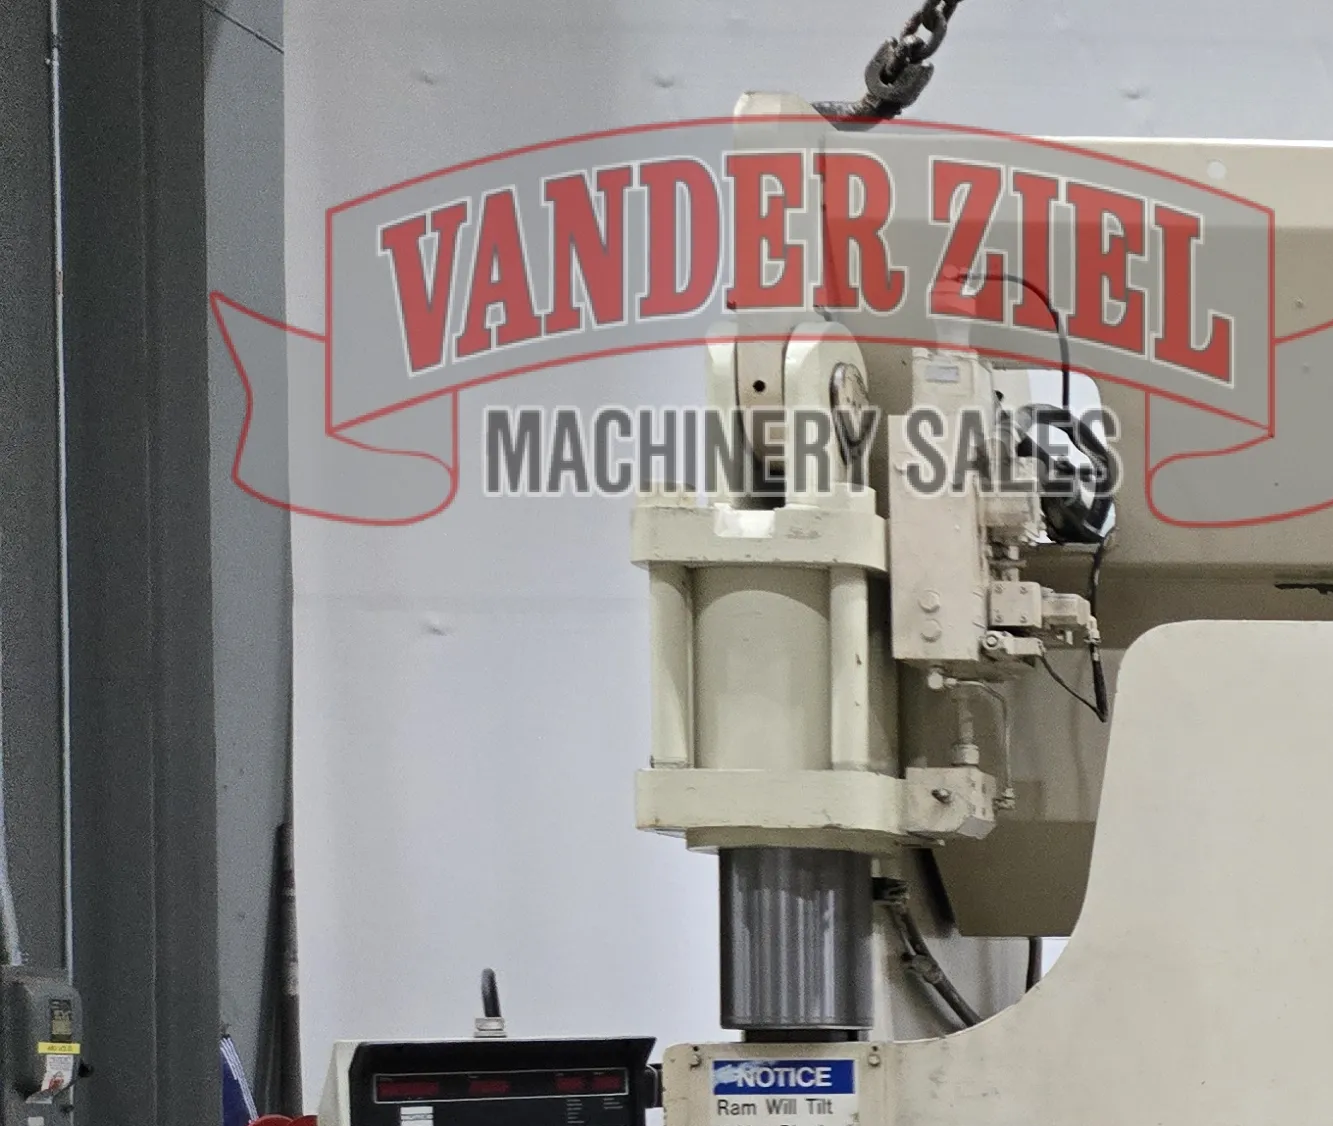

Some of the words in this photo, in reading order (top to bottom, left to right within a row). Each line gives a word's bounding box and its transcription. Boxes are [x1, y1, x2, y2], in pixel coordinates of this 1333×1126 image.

[736, 1066, 833, 1088] NOTICE
[717, 1099, 757, 1116] Ram
[765, 1099, 797, 1115] Will
[806, 1098, 834, 1115] Tilt
